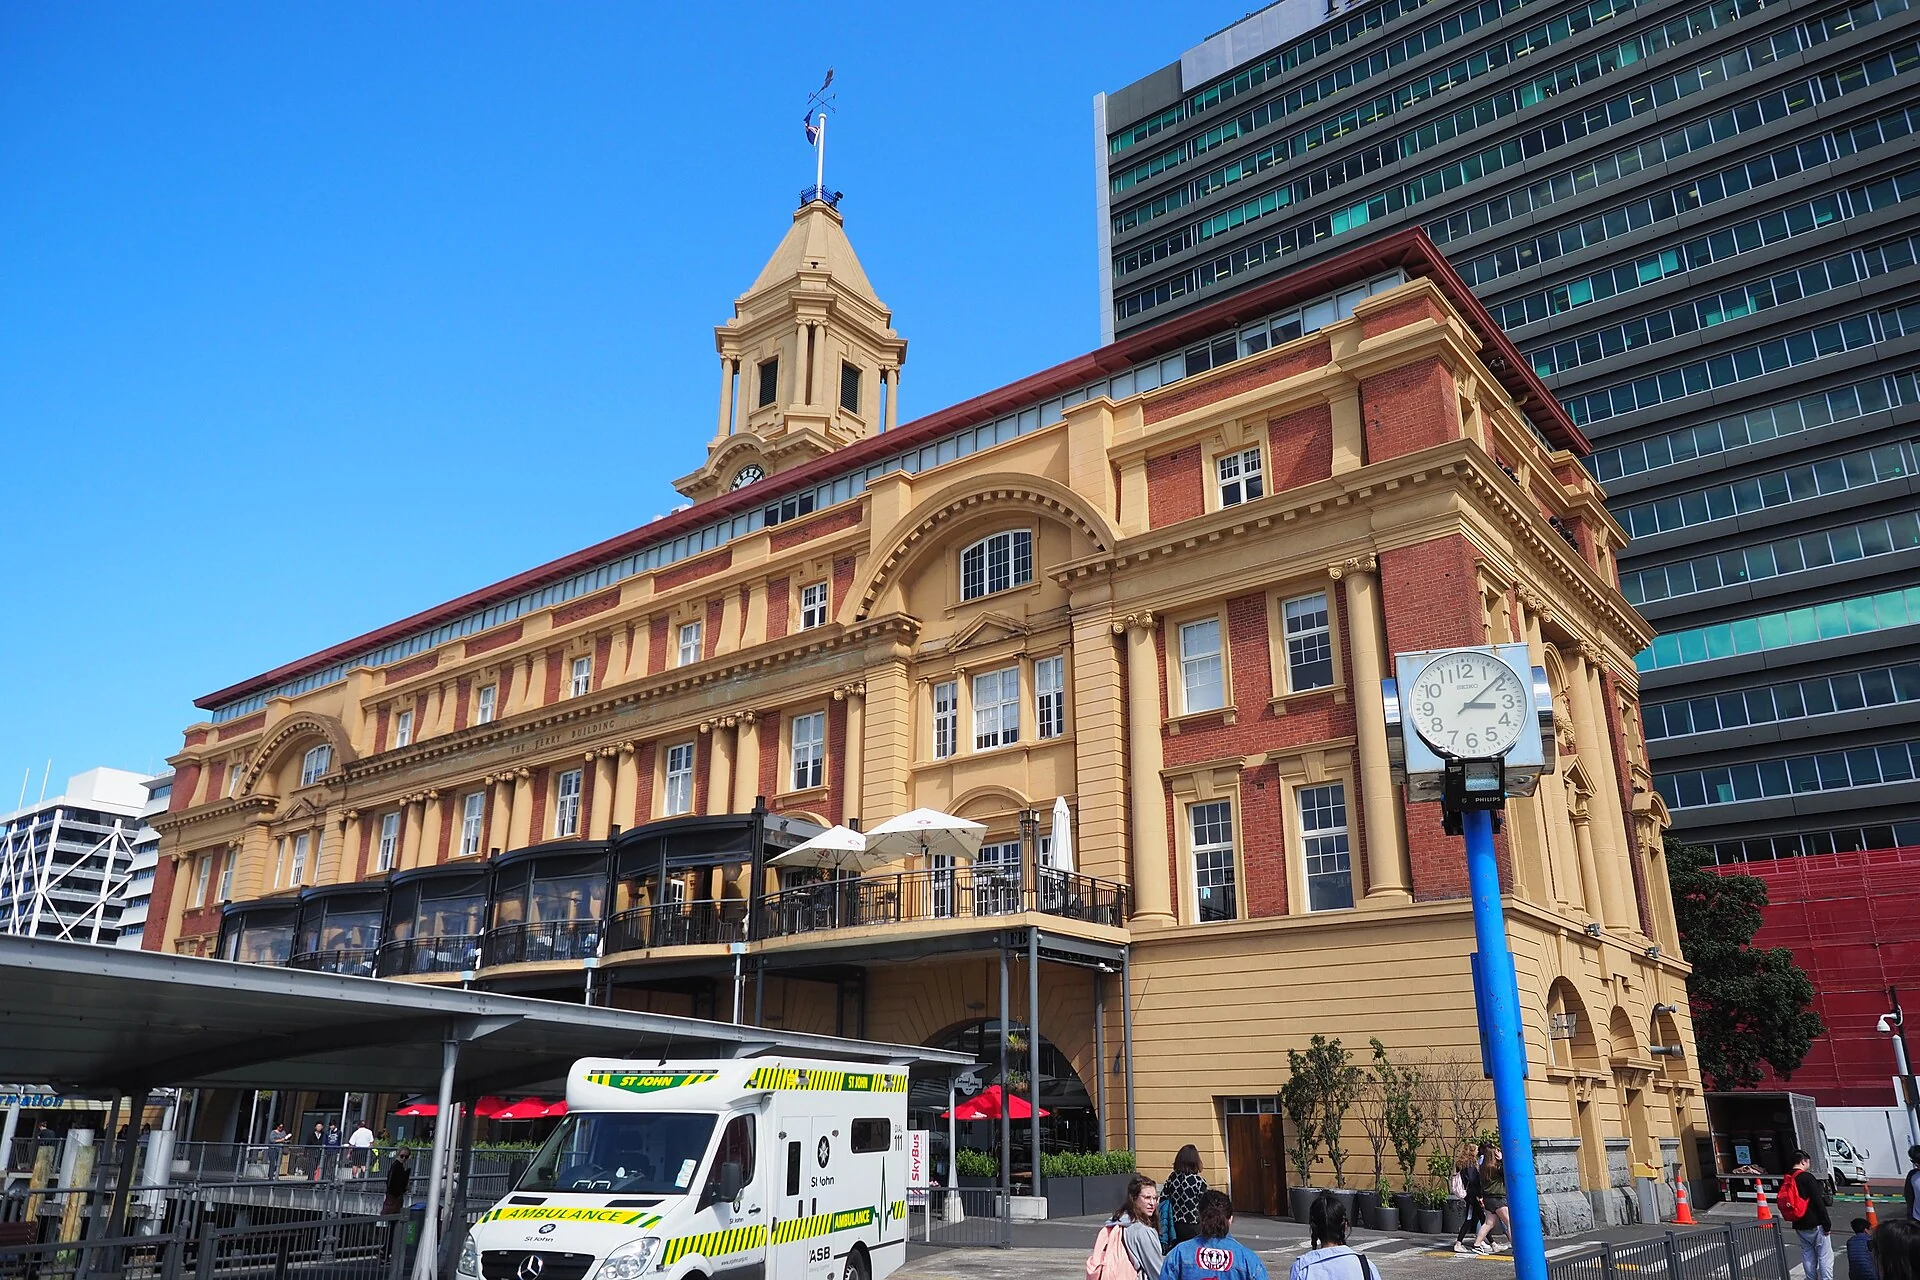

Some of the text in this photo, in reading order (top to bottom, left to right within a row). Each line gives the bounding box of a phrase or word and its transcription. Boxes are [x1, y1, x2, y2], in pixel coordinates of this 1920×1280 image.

[1440, 669, 1453, 684] 11
[1456, 664, 1474, 679] 12
[1482, 666, 1487, 680] 1
[1425, 683, 1442, 698] 10
[1495, 677, 1507, 692] 2
[1501, 694, 1515, 709] 3
[1422, 702, 1435, 717] 9
[1431, 717, 1443, 732] 8
[1498, 712, 1511, 727] 4
[511, 720, 616, 754] THE FERRY BUILDING
[1447, 730, 1459, 745] 7
[1465, 732, 1478, 748] 6
[1485, 727, 1498, 742] 5
[620, 1076, 674, 1086] ST JOHN
[848, 1077, 868, 1089] ST JOHN
[894, 1134, 903, 1151] 111
[912, 1134, 920, 1181] SkyBus
[811, 1176, 818, 1187] St
[506, 1209, 622, 1222] AMBULANCE
[835, 1210, 870, 1229] AMBULANCE
[809, 1246, 831, 1264] ASB
